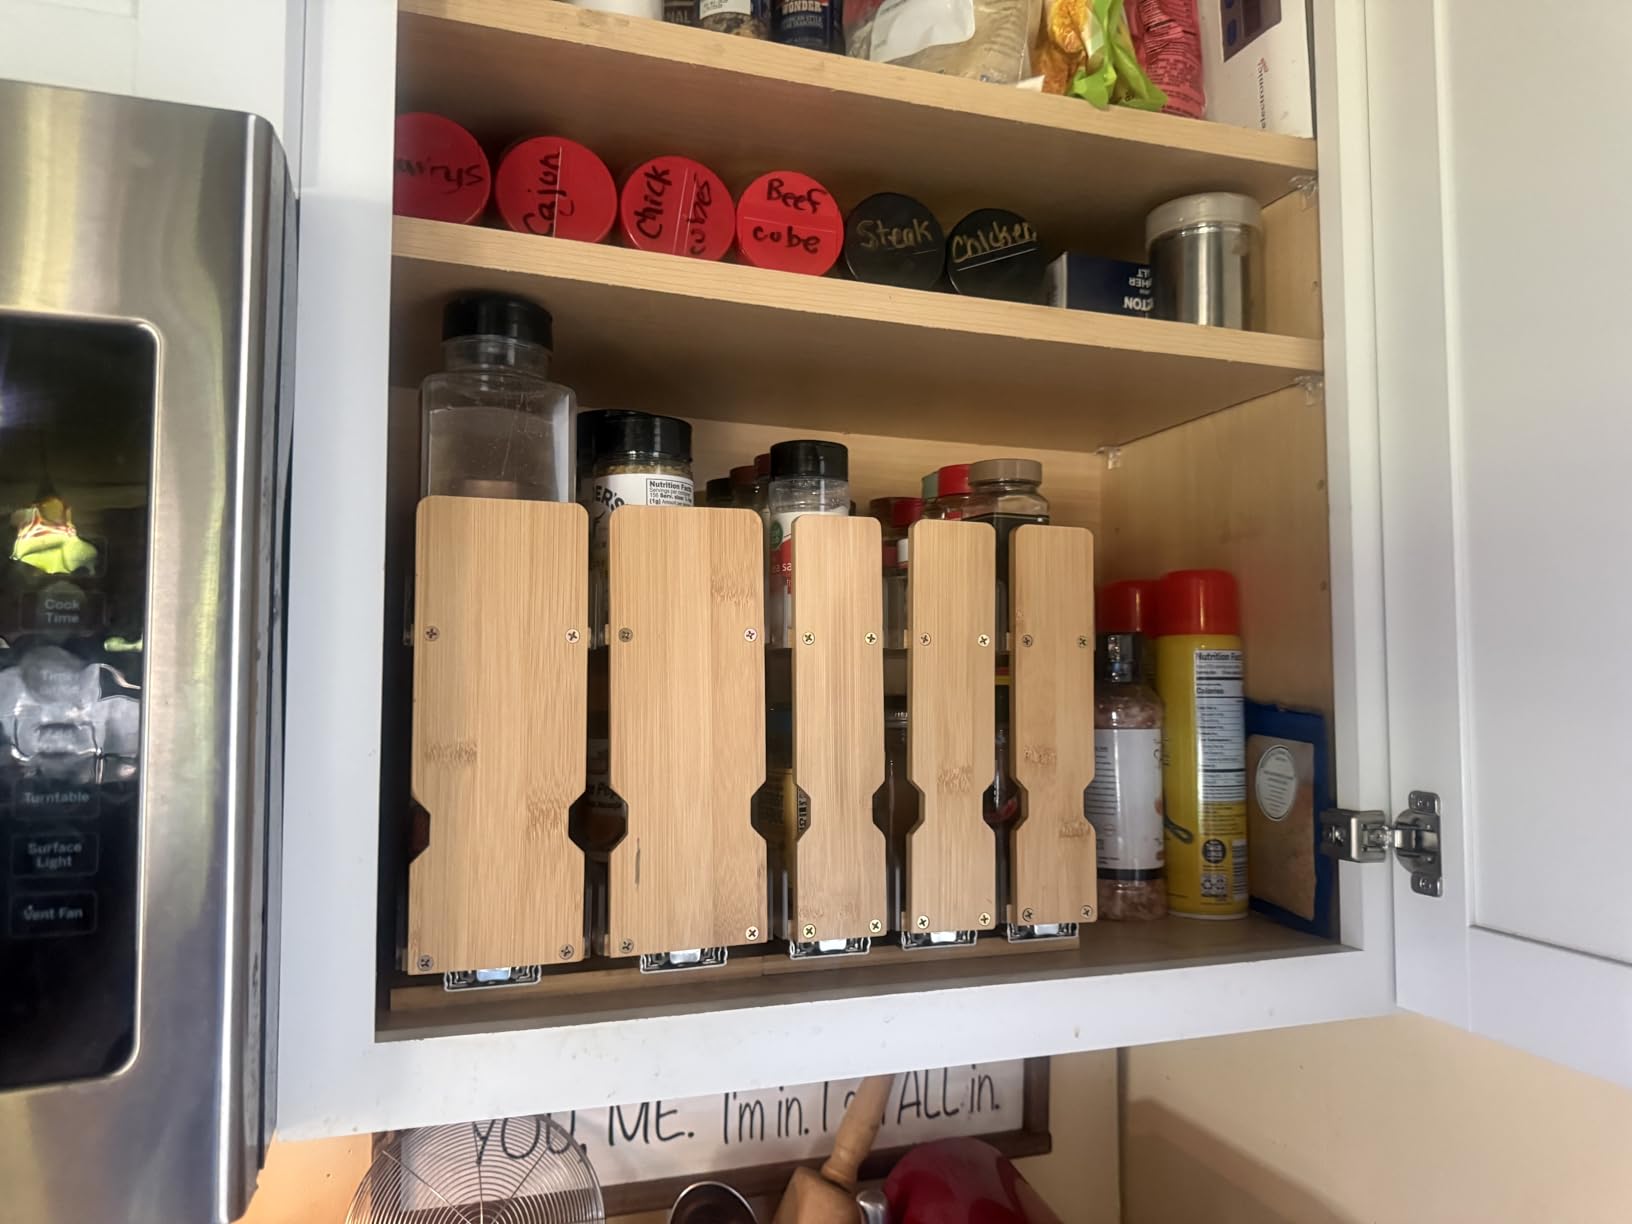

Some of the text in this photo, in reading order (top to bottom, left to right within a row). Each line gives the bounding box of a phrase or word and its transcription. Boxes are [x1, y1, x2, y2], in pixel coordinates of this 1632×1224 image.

[523, 151, 575, 236] Cajun
[766, 178, 826, 213] Beef
[633, 165, 672, 239] Chick
[752, 225, 820, 253] cube
[856, 219, 932, 248] Steak
[649, 481, 680, 490] Nutrition
[45, 599, 80, 610] Cook
[46, 612, 80, 624] Time
[24, 792, 90, 803] Turntable
[28, 842, 82, 854] Surface
[36, 856, 72, 869] Light
[24, 907, 83, 920] Vent Fan
[723, 1091, 764, 1144] I'm
[776, 1086, 809, 1137] in.
[897, 1067, 959, 1125] ALL
[969, 1064, 1000, 1113] in.
